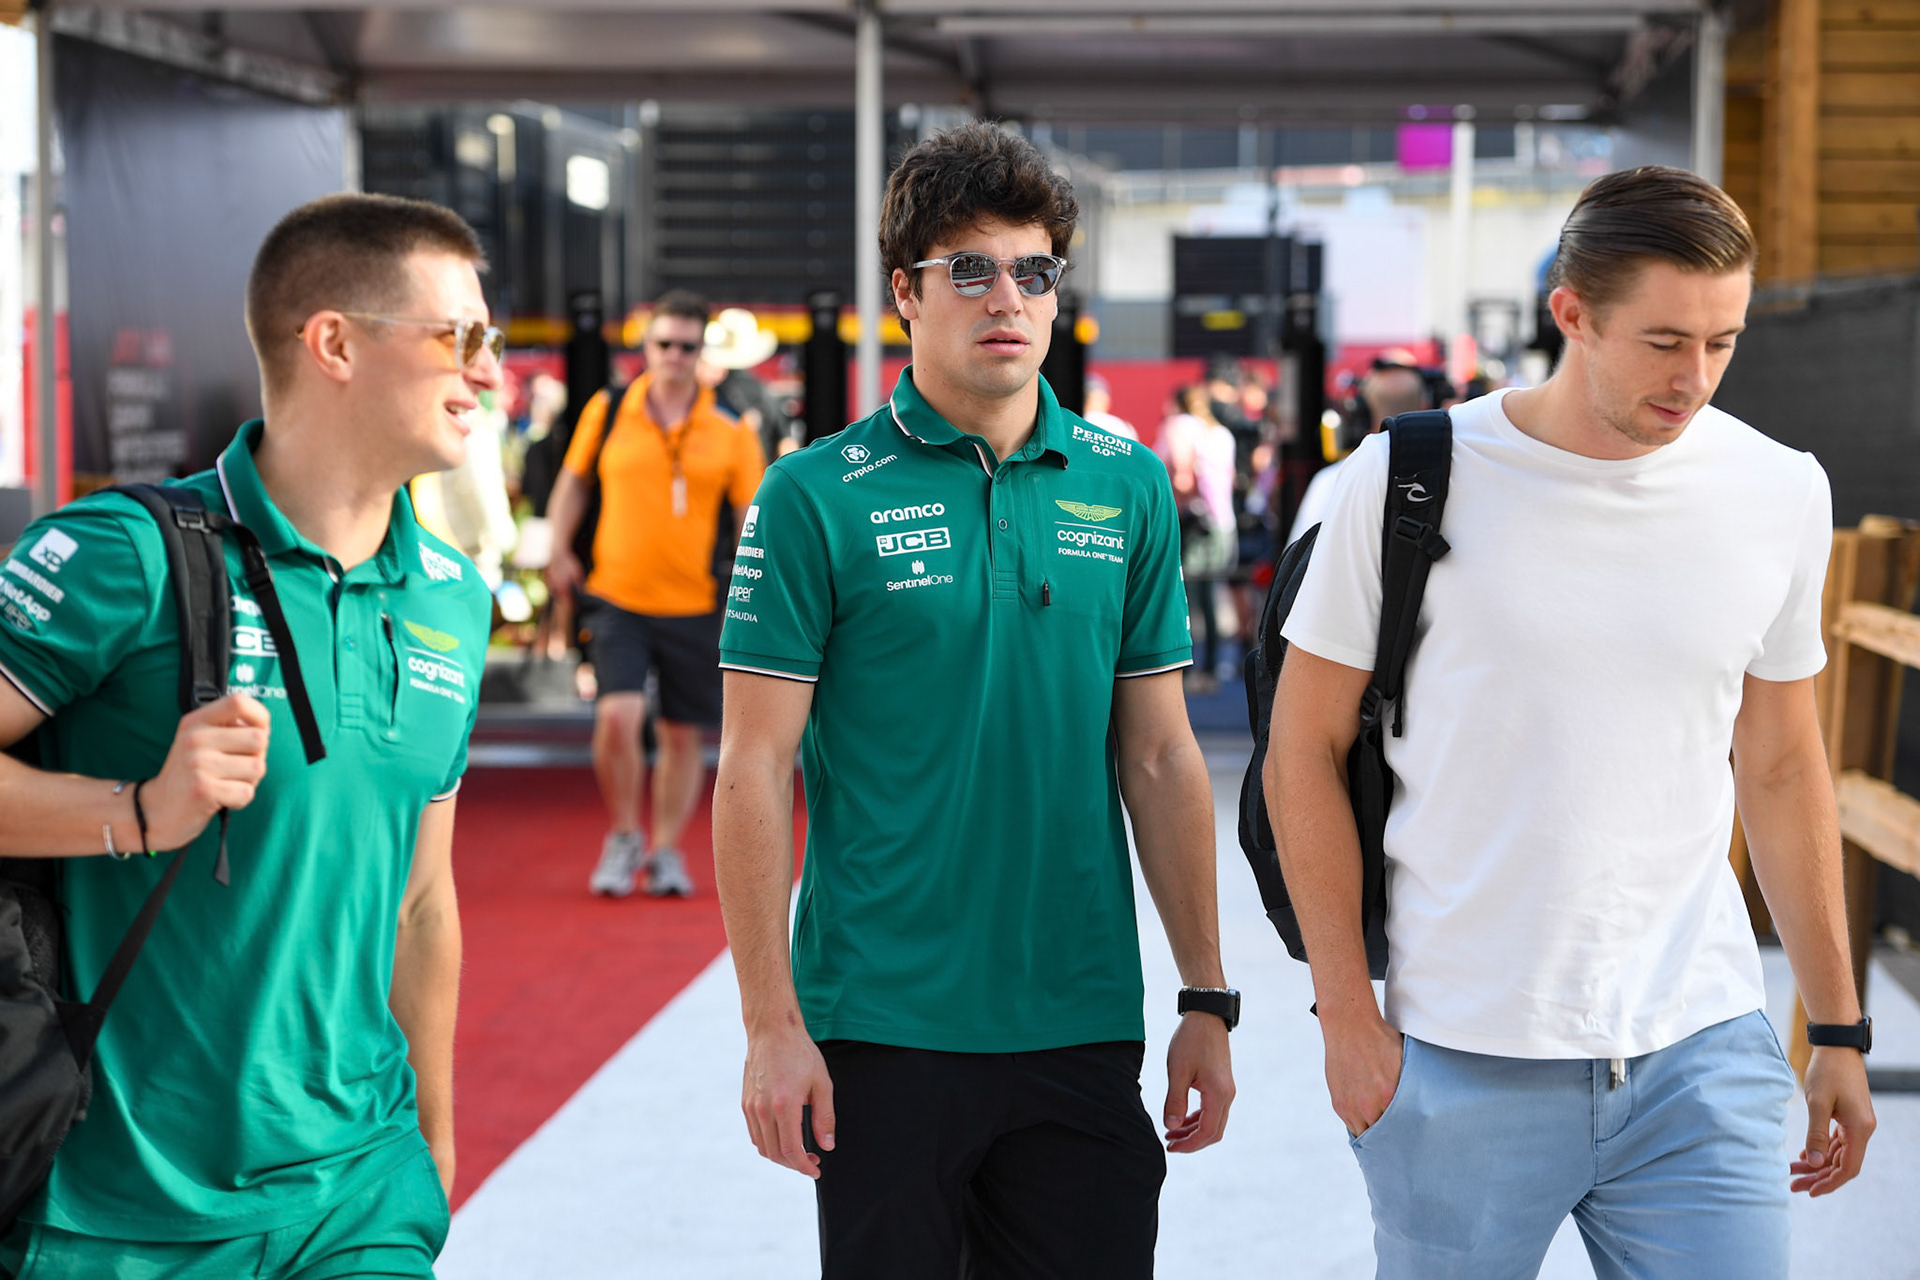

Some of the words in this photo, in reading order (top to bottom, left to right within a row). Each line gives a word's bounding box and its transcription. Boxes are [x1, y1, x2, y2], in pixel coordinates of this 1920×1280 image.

[1073, 425, 1132, 452] PERONI
[1092, 445, 1116, 457] 0.0%
[842, 454, 898, 483] crypto.com
[870, 503, 945, 524] aramco
[880, 530, 948, 554] JCB
[1057, 530, 1124, 550] cognizant
[1058, 547, 1091, 558] FORMULA
[1108, 553, 1123, 564] TEAM
[732, 564, 763, 580] NetApp
[886, 574, 953, 592] SentinelOne
[4, 580, 51, 622] NetApp
[231, 629, 278, 653] CB
[408, 657, 464, 687] cognizant
